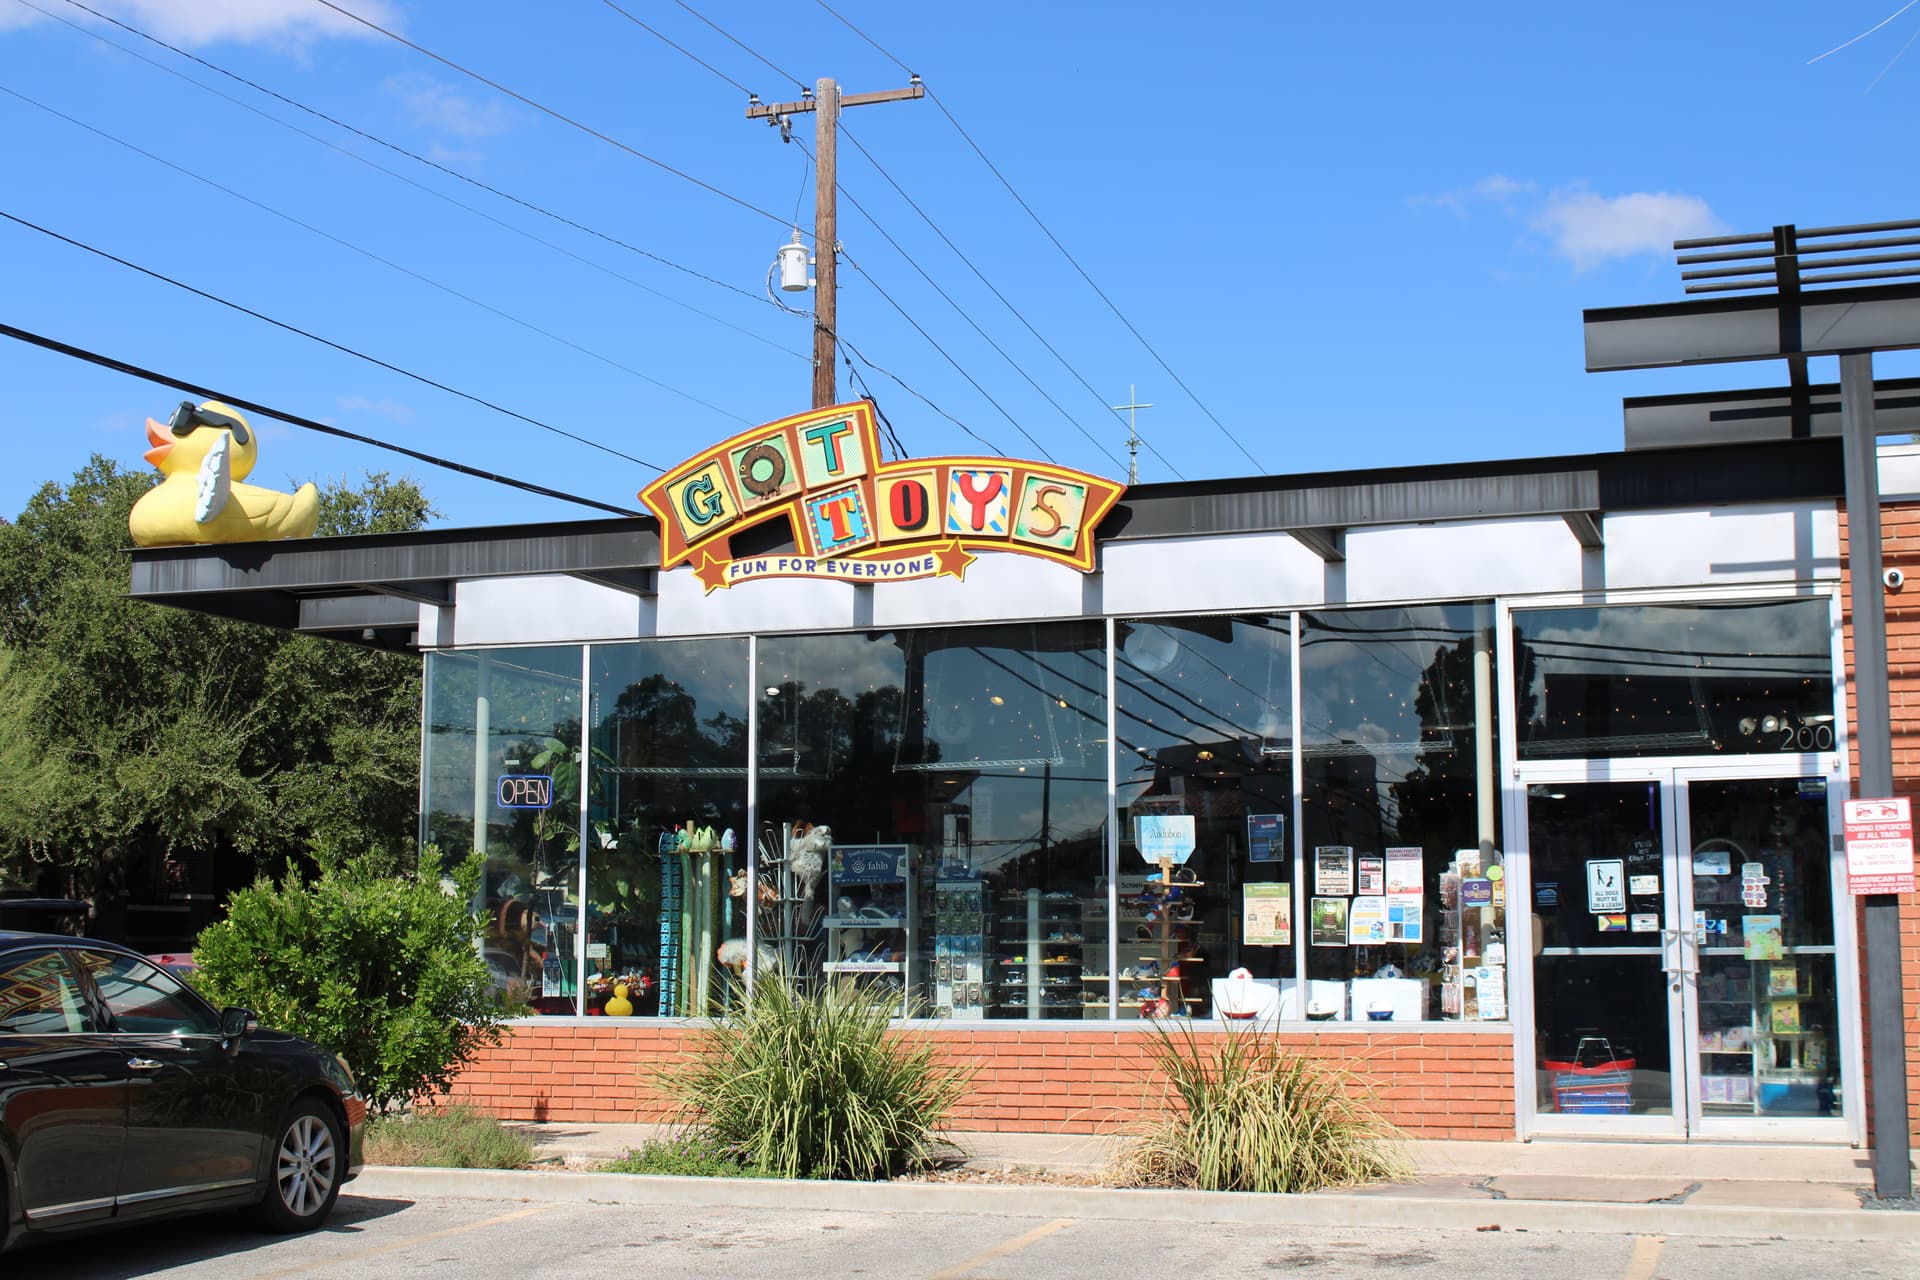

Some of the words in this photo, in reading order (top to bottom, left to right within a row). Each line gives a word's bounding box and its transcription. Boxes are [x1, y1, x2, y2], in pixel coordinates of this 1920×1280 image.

[682, 421, 854, 525] GOT
[819, 472, 1070, 542] TOYS
[730, 560, 768, 578] FUN
[778, 558, 817, 573] FOR
[827, 556, 934, 577] EVERYONE
[1780, 725, 1833, 751] 200
[500, 779, 549, 804] OPEN
[1151, 827, 1182, 839] Audubon
[1857, 831, 1866, 839] AT
[1866, 831, 1880, 839] ALL
[1875, 823, 1911, 831] ENFORCED
[868, 861, 888, 870] fahlo
